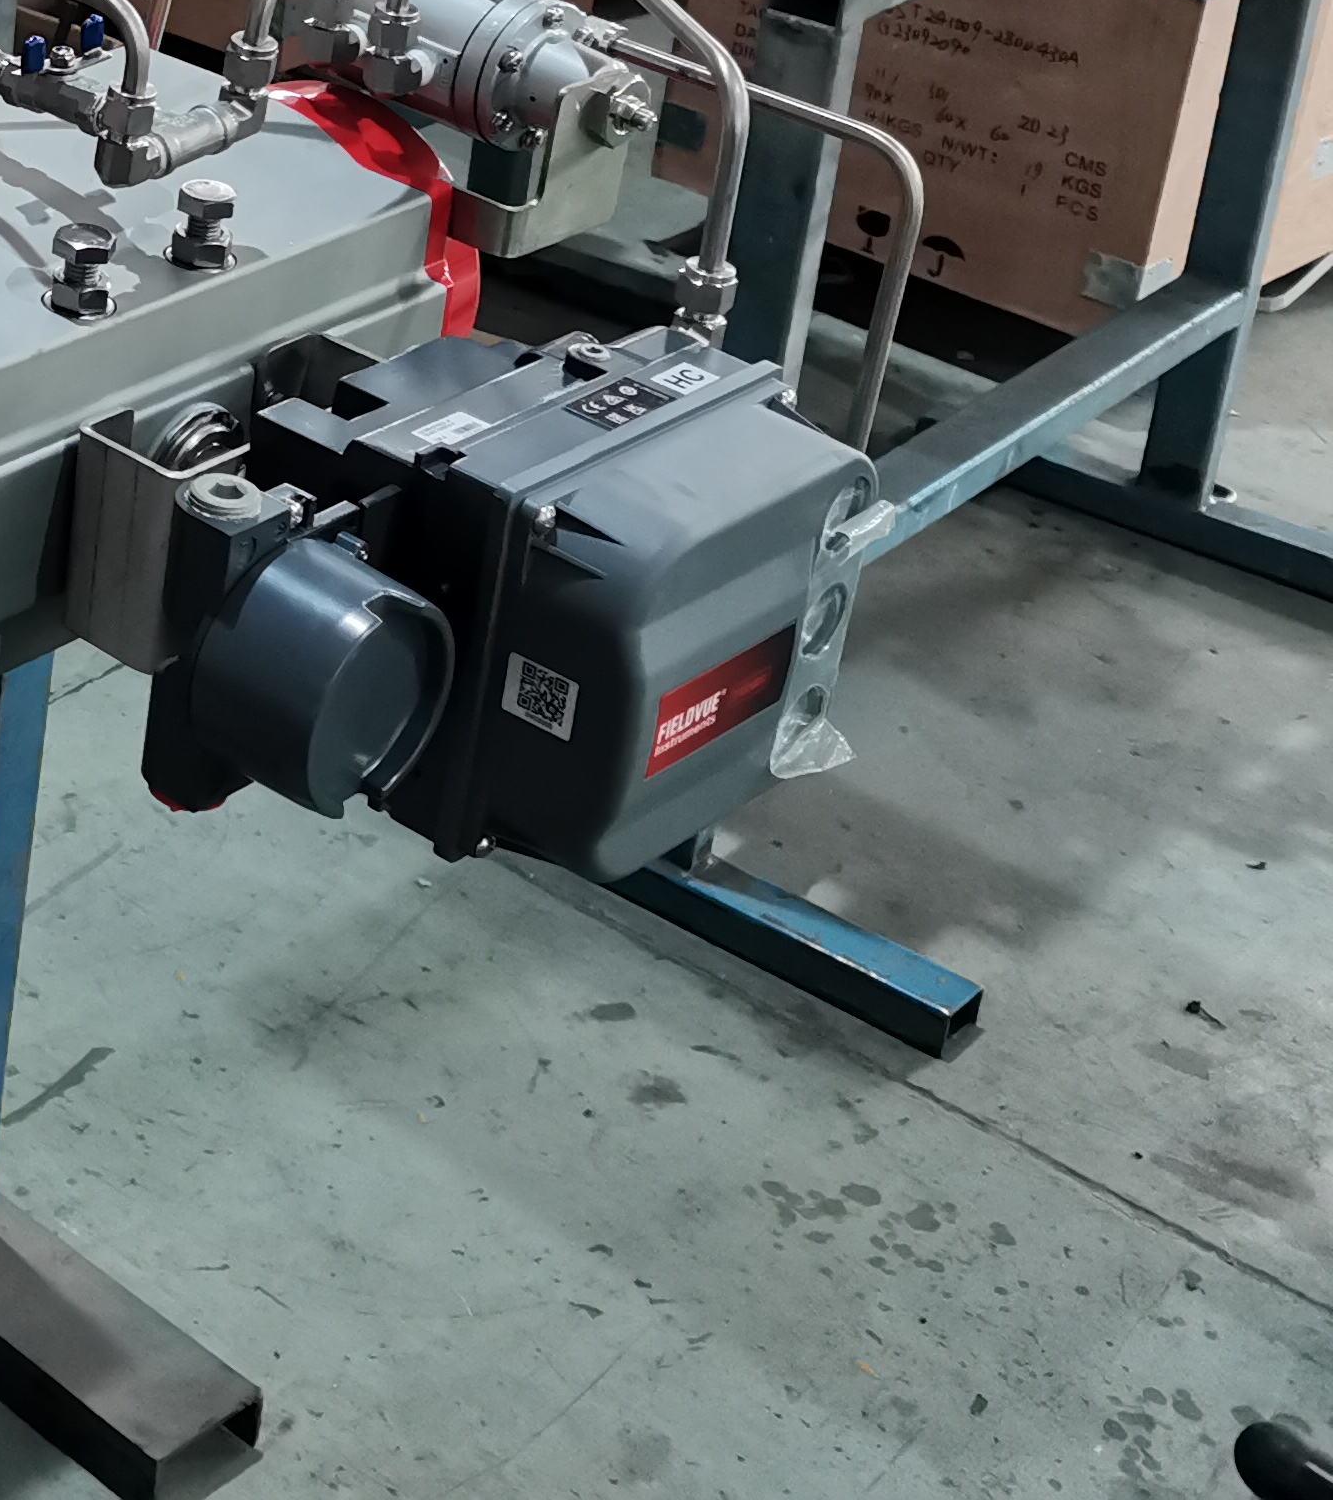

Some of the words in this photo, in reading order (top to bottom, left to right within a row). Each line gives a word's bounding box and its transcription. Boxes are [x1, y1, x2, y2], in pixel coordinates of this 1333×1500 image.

[1064, 151, 1108, 178] CMS
[1060, 174, 1103, 199] KGS
[664, 368, 705, 390] HC
[656, 690, 722, 745] FIELDVUE
[653, 714, 717, 758] Instruments
